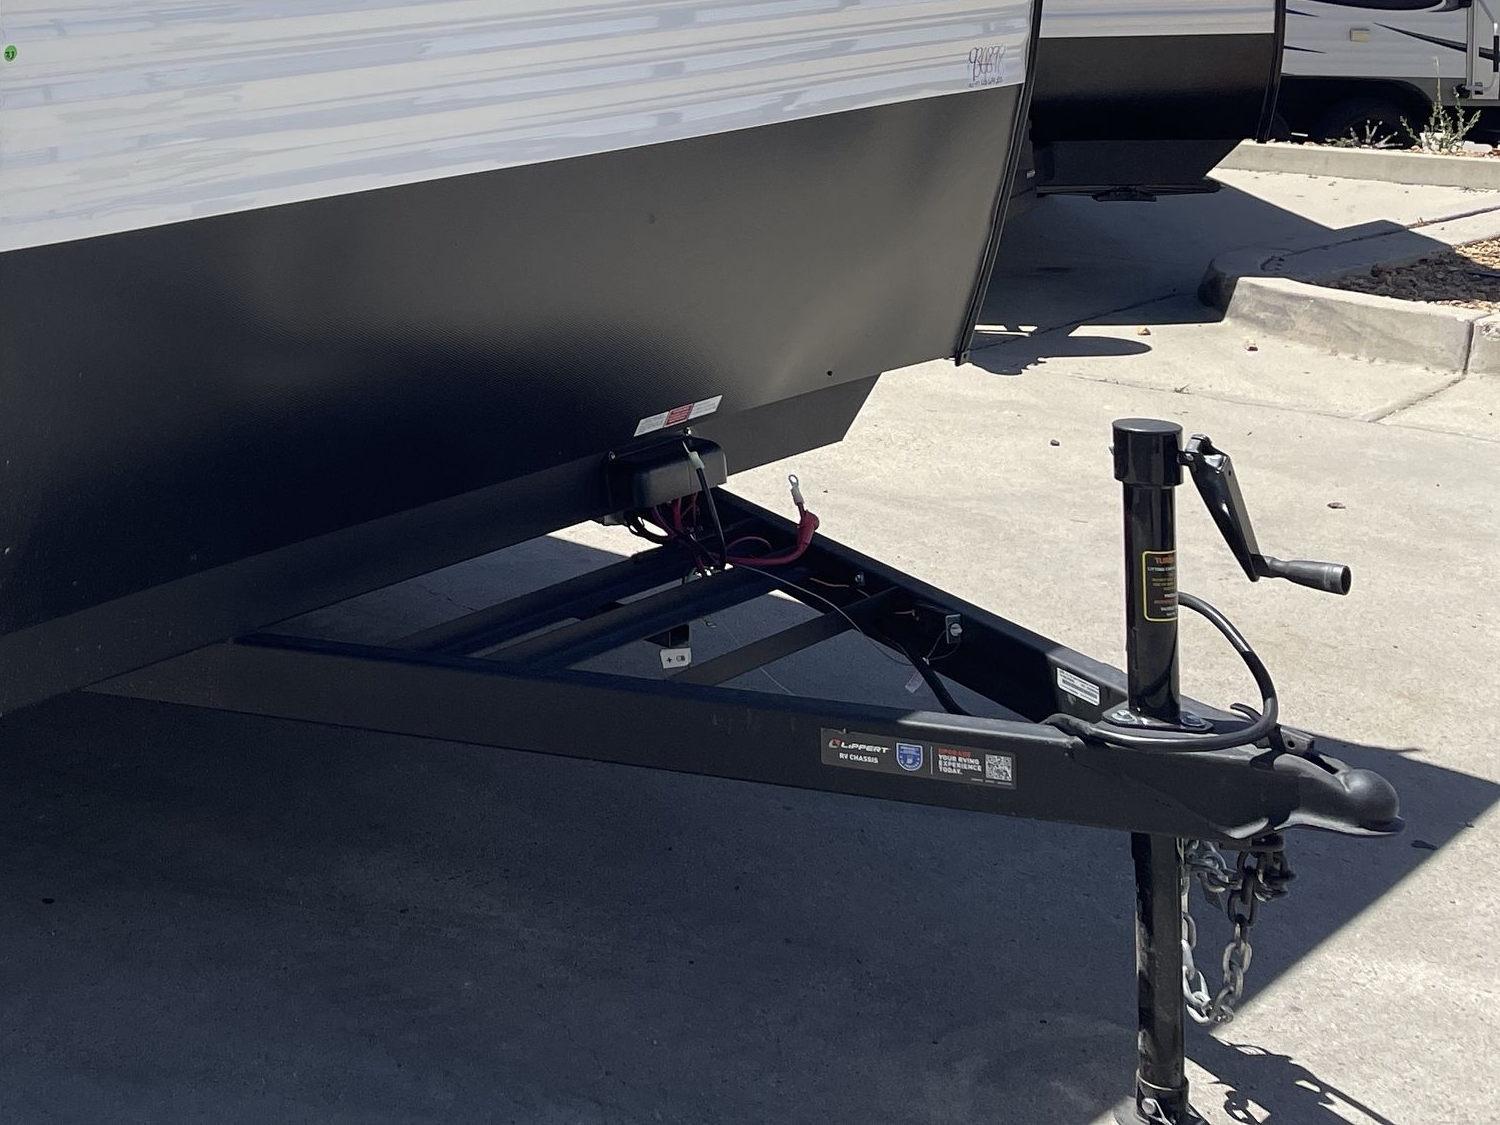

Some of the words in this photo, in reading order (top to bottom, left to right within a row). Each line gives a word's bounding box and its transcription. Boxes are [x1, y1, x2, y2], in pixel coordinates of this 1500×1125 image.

[840, 741, 890, 754] LIPPERT
[839, 752, 849, 760] RV
[849, 754, 879, 764] CHASSIS
[938, 754, 957, 762] YOUR
[958, 756, 980, 765] RVING
[938, 759, 982, 772] EXPERIENCE
